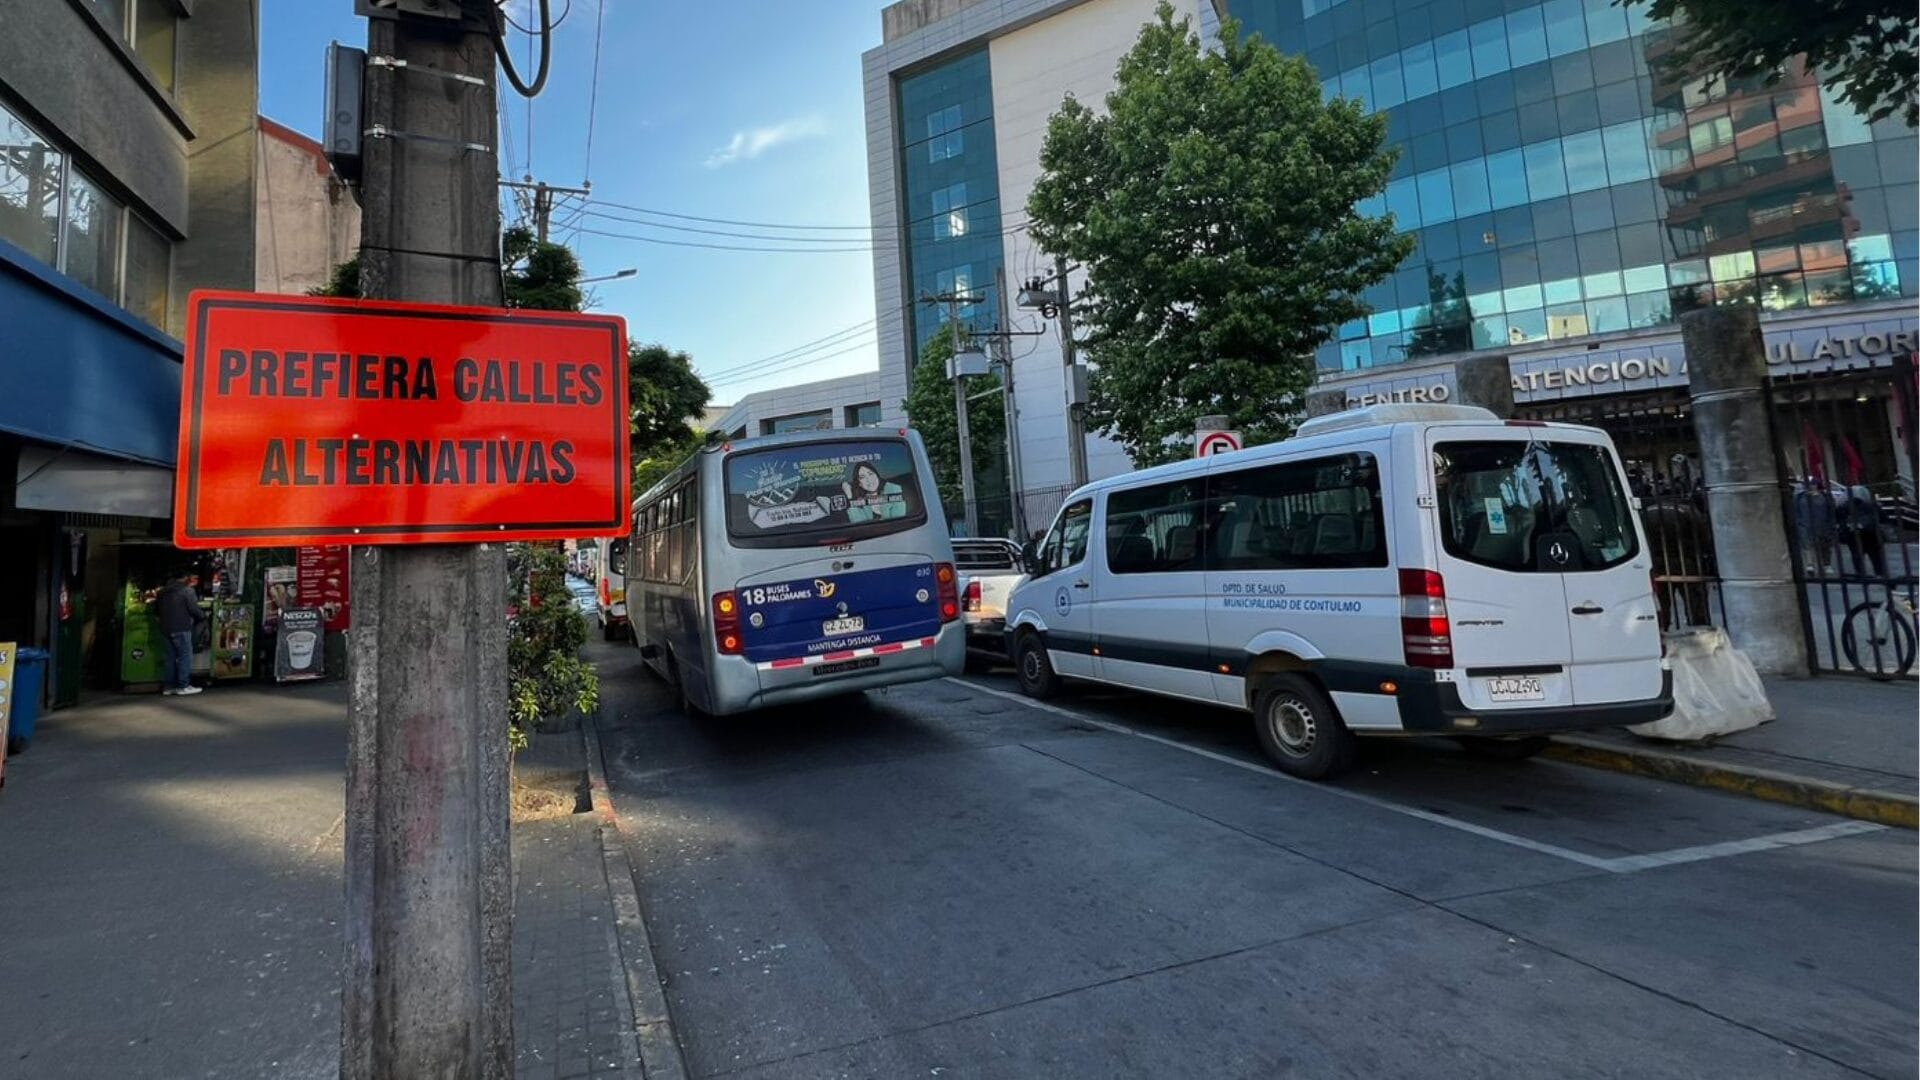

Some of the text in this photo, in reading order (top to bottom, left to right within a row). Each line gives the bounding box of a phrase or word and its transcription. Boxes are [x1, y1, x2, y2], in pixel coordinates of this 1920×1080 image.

[217, 349, 602, 406] PREFIERA CALLES
[1346, 332, 1918, 410] CENTRO ATENCION ULATOR
[259, 438, 575, 486] ALTERNATIVAS
[742, 588, 766, 606] 18
[766, 584, 790, 594] BUSES
[767, 590, 811, 603] PALOMARES
[1245, 583, 1256, 593] DE
[1257, 584, 1286, 595] SALUD
[1223, 598, 1361, 612] MUNICIPALIDAD DE CONTULMO
[807, 635, 881, 652] MANTENGA DISTANCIA
